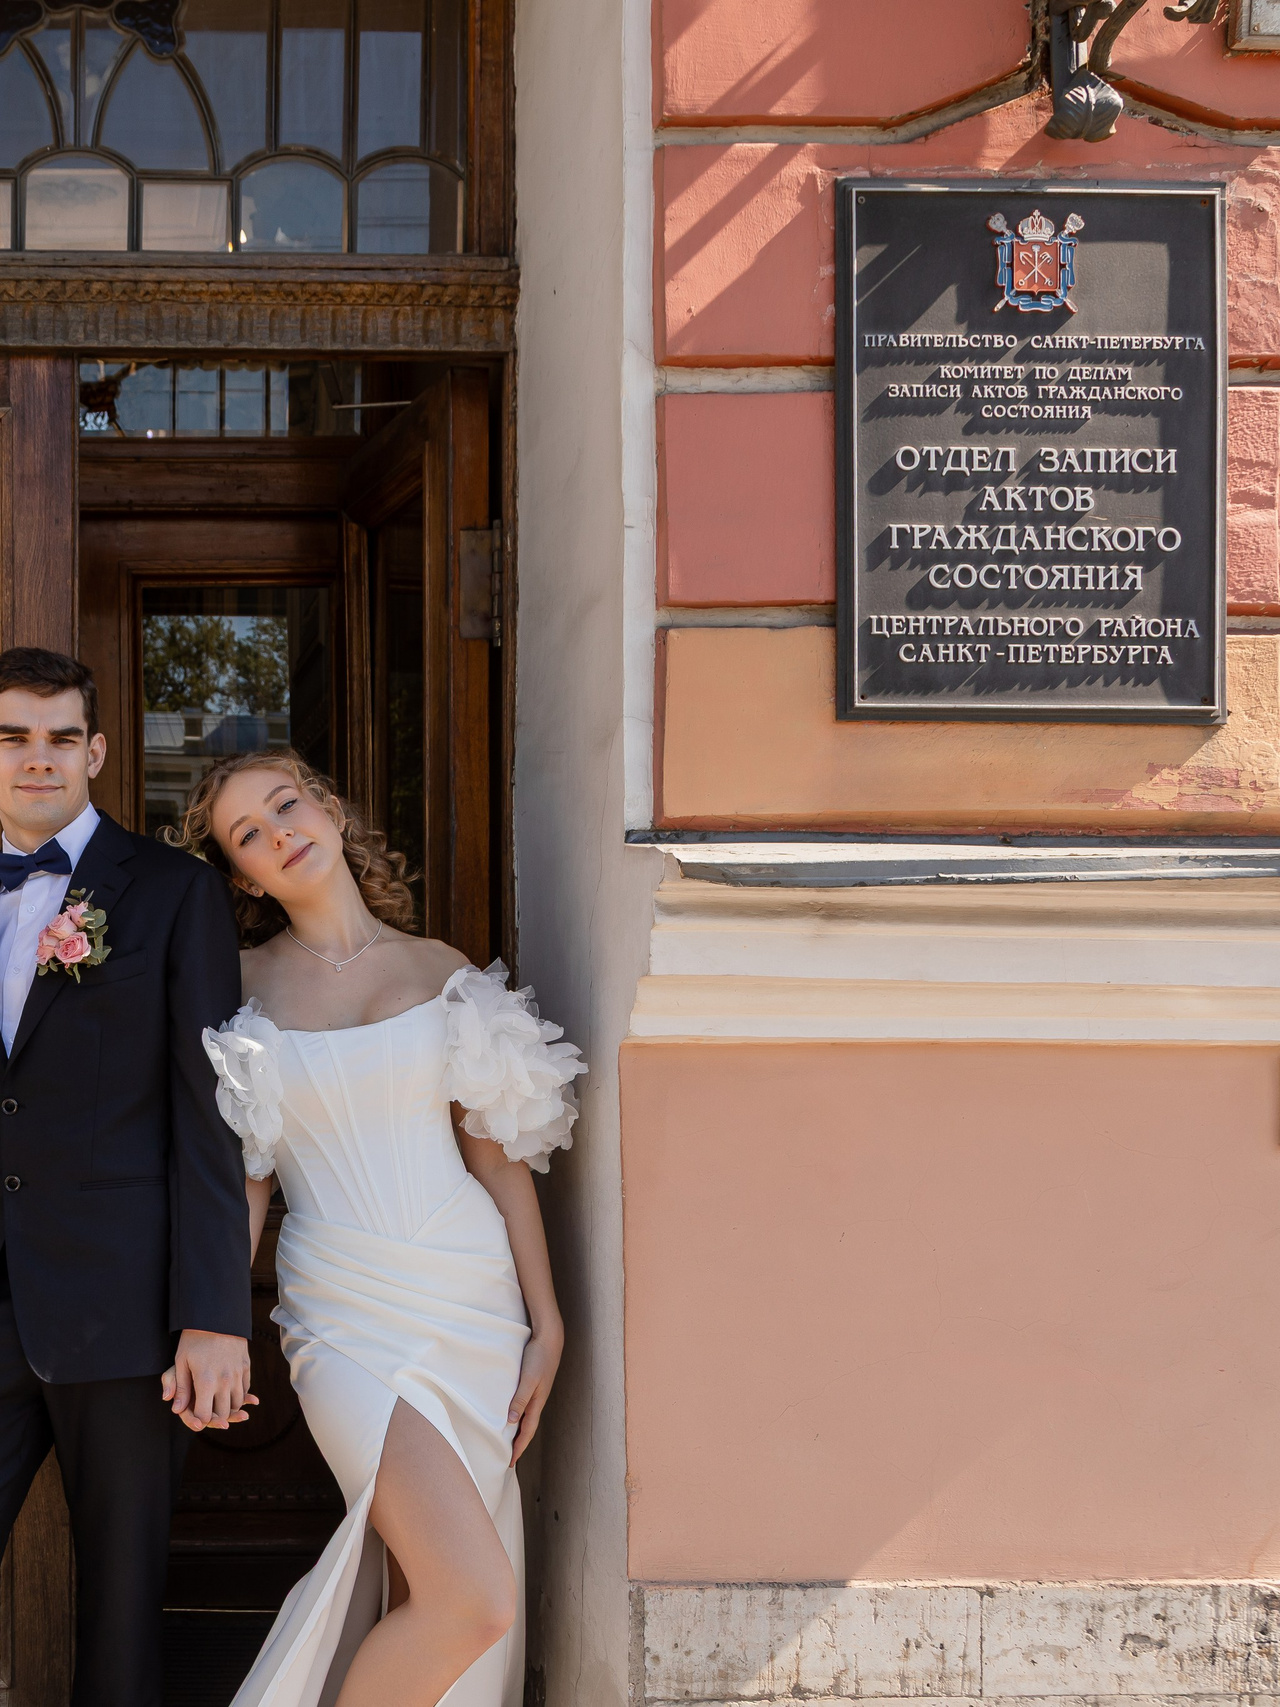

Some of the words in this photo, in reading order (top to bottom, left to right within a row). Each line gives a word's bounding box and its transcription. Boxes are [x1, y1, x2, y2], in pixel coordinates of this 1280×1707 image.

[863, 334, 1018, 350] ПРАВИТЕЛЬСТВО
[1031, 336, 1206, 351] САНКТ-ПЕТЕРБУРГА
[939, 366, 1025, 380] КОМИТЕТ
[1035, 367, 1059, 380] ПО
[1068, 367, 1132, 382] ДЕЛАМ
[888, 385, 962, 398] ЗАПИСИ
[972, 385, 1028, 399] АКТОВ
[1037, 386, 1183, 402] ГРАЖДАНСКОГО
[982, 405, 1092, 420] СОСТОЯНИЯ
[895, 446, 1017, 477] ОТДЕЛ
[1039, 448, 1178, 474] ЗАПИСИ
[978, 487, 1096, 512] АКТОВ
[888, 524, 1182, 556] ГРАЖДАНСКОГО
[928, 564, 1144, 591] СОСТОЯНИЯ
[870, 615, 1084, 638] ЦЕНТРАЛЬНОГО
[1099, 615, 1201, 639] РАЙОНА
[898, 644, 1174, 665] САНКТ-ПЕТЕРБУРГА
